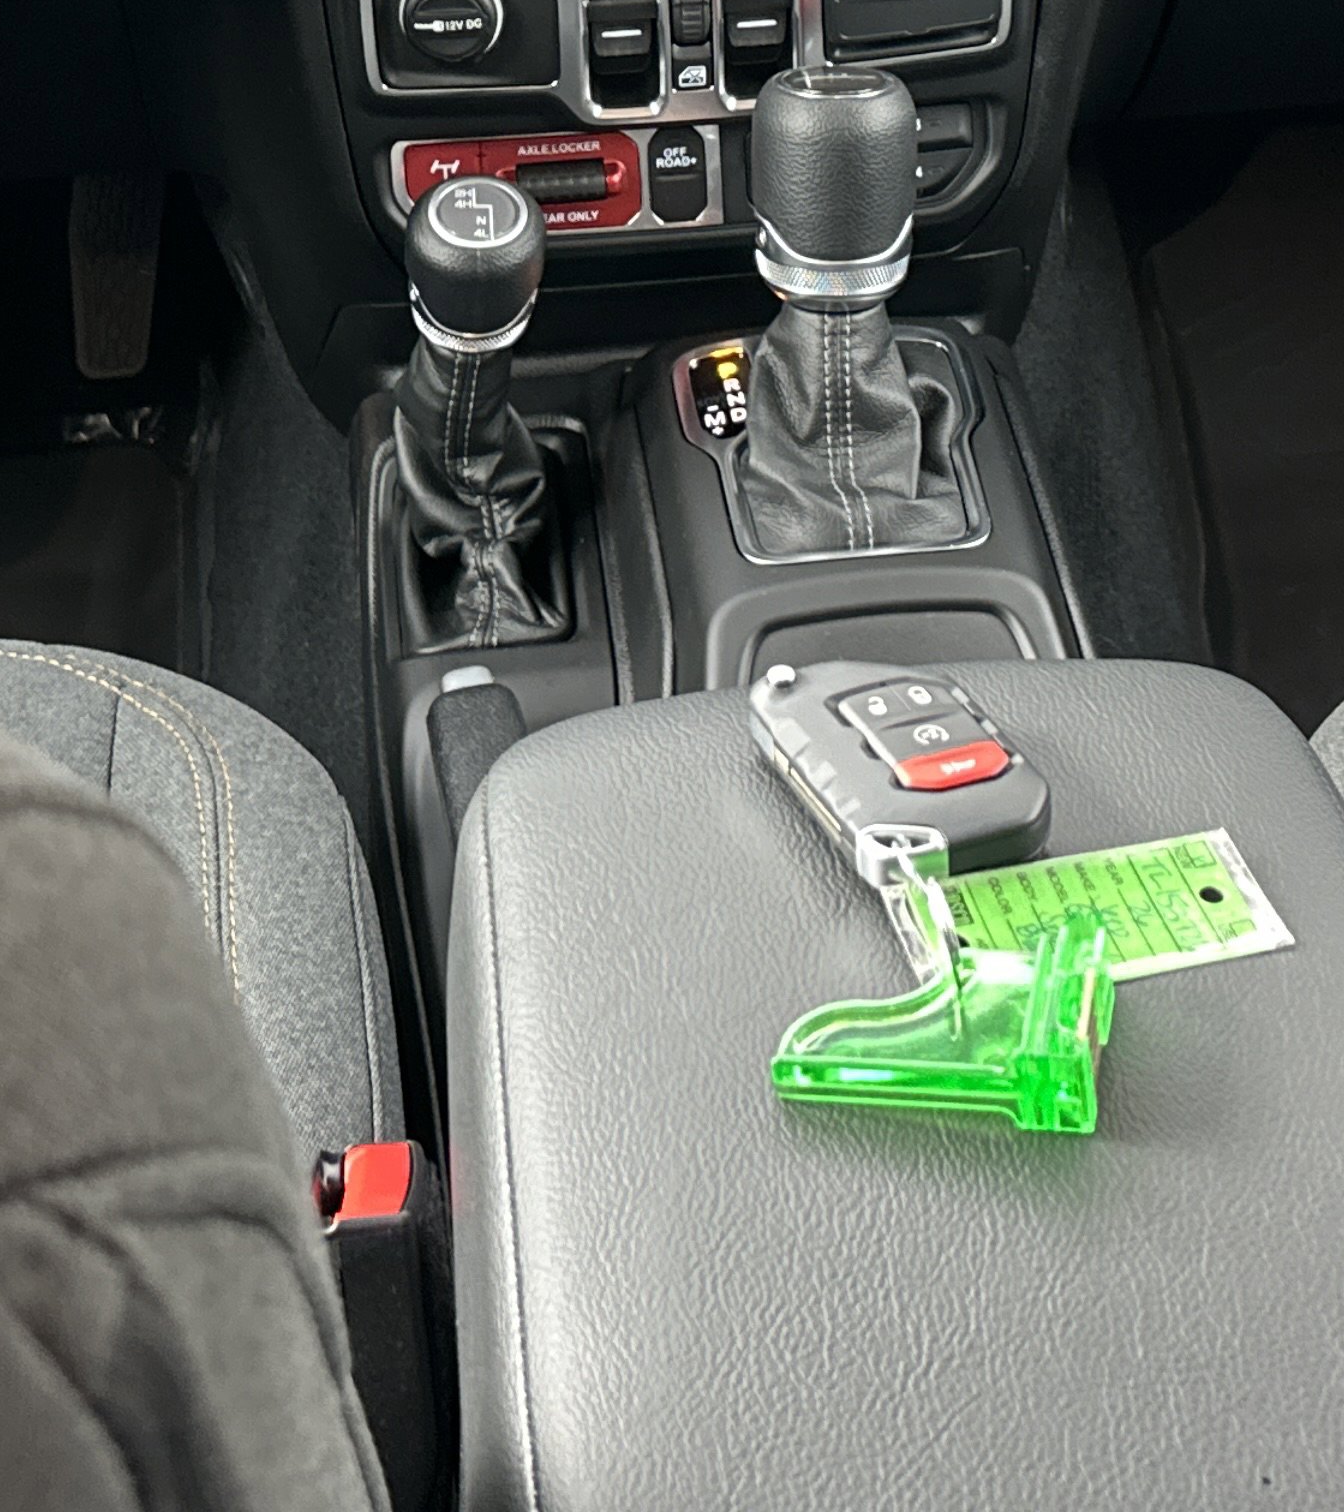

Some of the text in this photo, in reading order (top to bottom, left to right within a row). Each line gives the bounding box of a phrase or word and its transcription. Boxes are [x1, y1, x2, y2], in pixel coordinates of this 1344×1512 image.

[445, 19, 463, 31] 12V
[517, 141, 600, 156] AXLE LOCKER
[663, 147, 686, 159] OFF
[455, 198, 473, 209] 4H
[476, 216, 487, 226] N
[543, 210, 599, 223] EAR ONLY
[473, 228, 489, 239] 4L
[727, 392, 746, 406] N
[704, 411, 726, 428] M
[730, 408, 747, 422] D
[1073, 861, 1097, 891] MAKE
[1104, 857, 1124, 885] YEAR
[1016, 872, 1037, 901] BODY
[1046, 866, 1068, 903] MODEL
[988, 877, 1013, 914] COLOR
